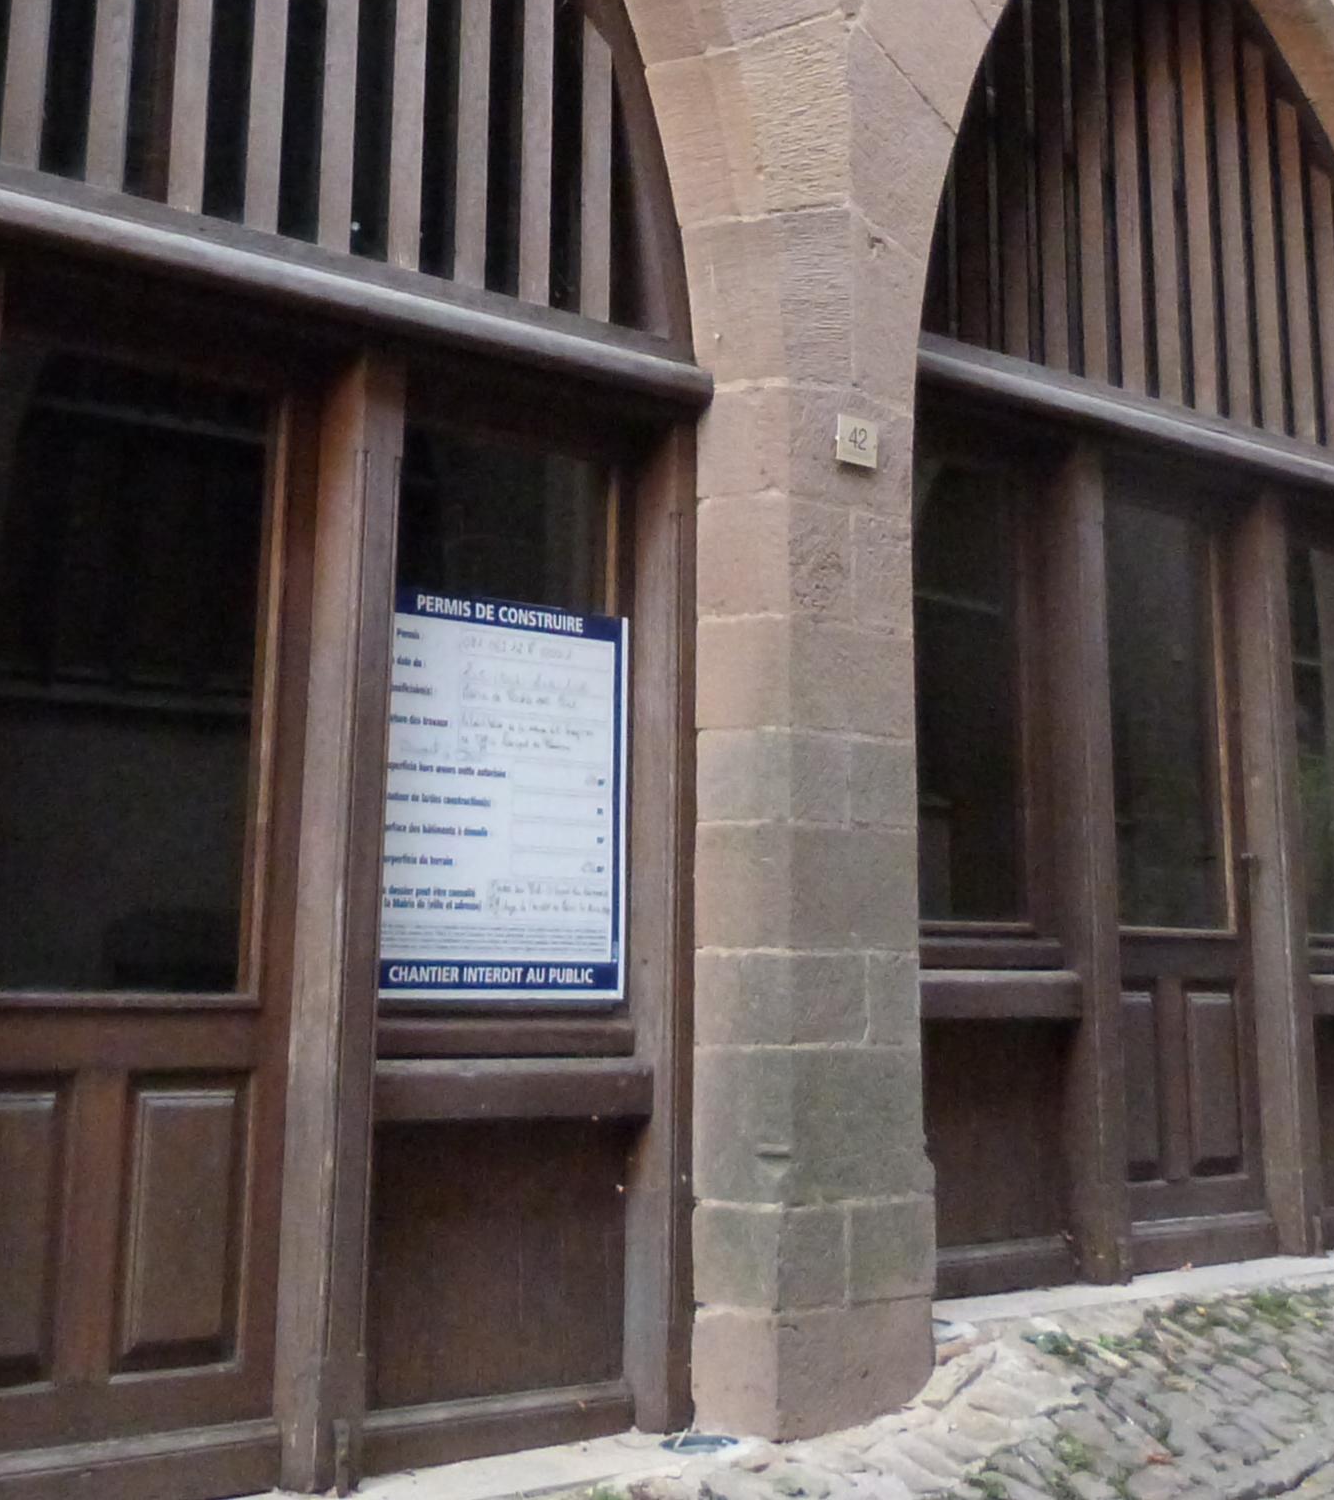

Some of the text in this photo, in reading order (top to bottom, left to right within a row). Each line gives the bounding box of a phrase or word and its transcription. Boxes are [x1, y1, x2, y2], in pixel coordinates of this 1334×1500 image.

[848, 426, 868, 451] 42
[417, 593, 584, 633] PERMIS DE CONSTRUIRE
[388, 965, 594, 984] CHANTIER INTERDIT AU PUBLIC
